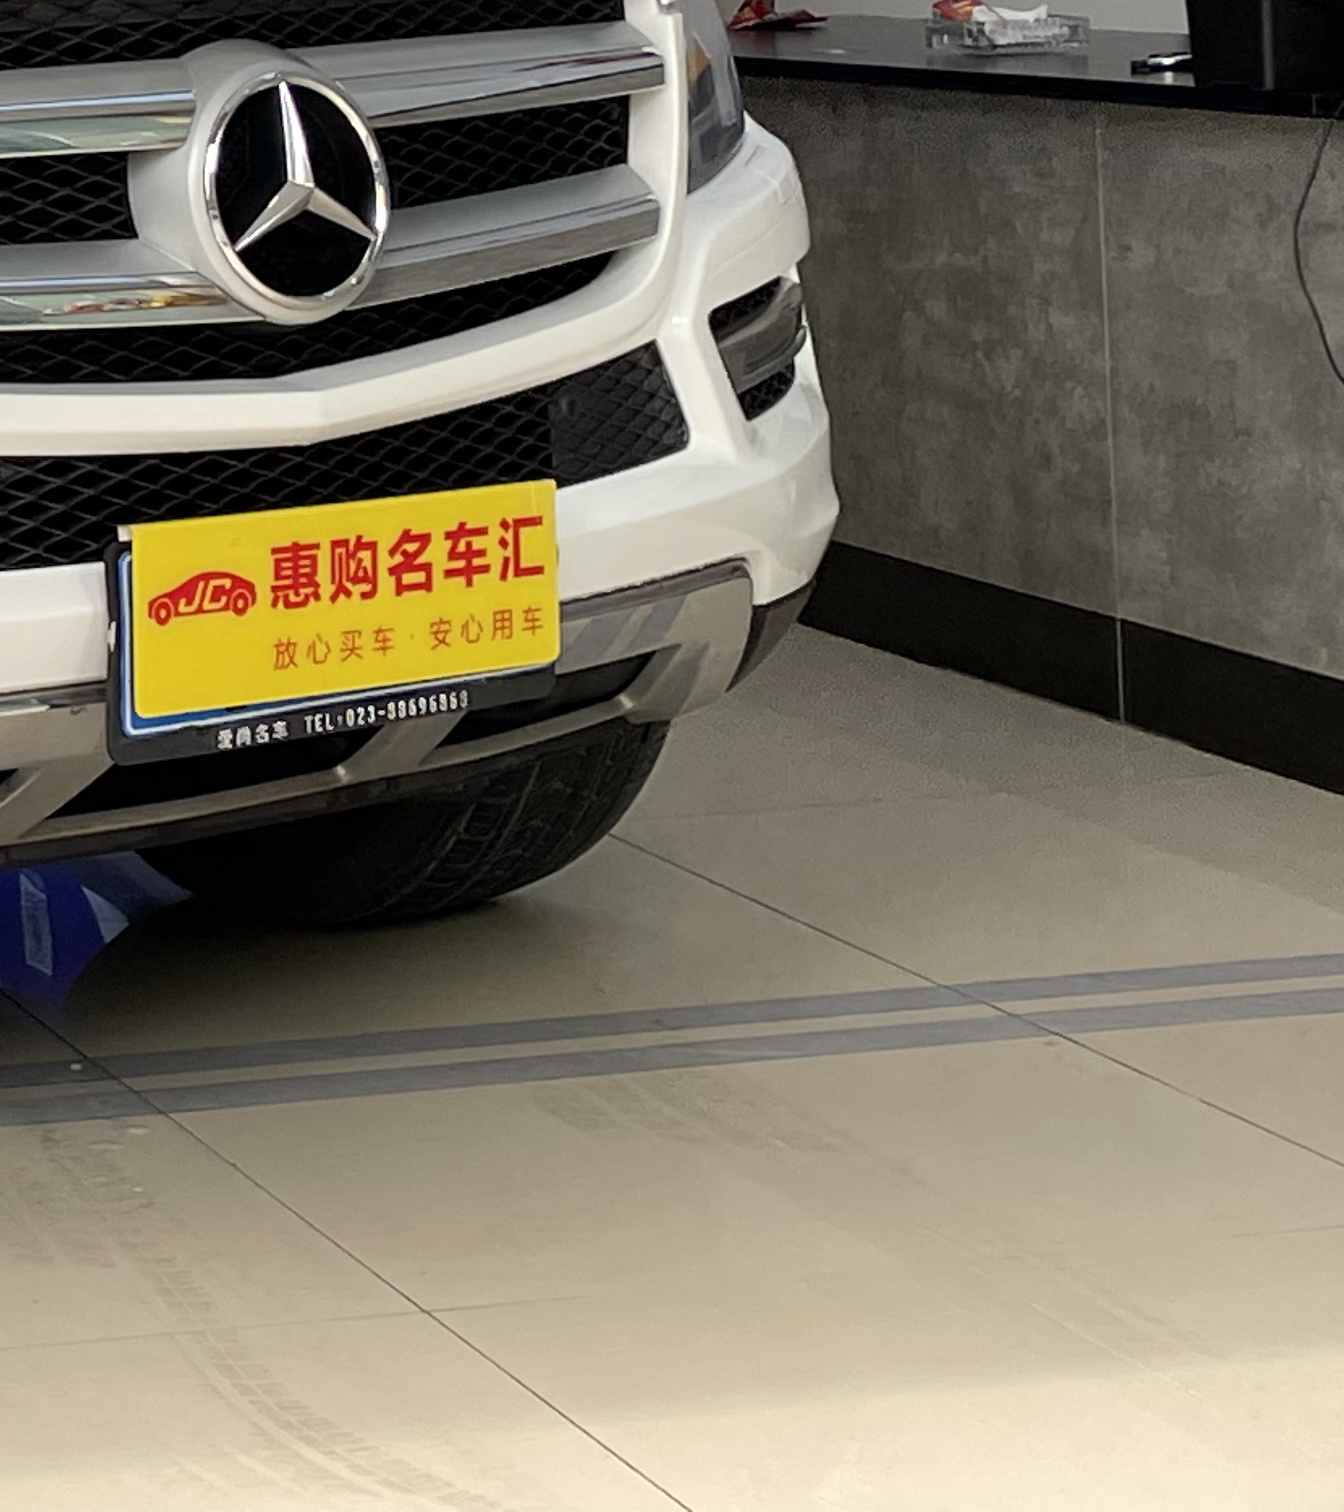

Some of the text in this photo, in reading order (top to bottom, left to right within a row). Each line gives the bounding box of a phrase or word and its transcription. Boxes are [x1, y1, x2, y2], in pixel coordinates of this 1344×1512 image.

[270, 515, 545, 611] 惠购名车汇
